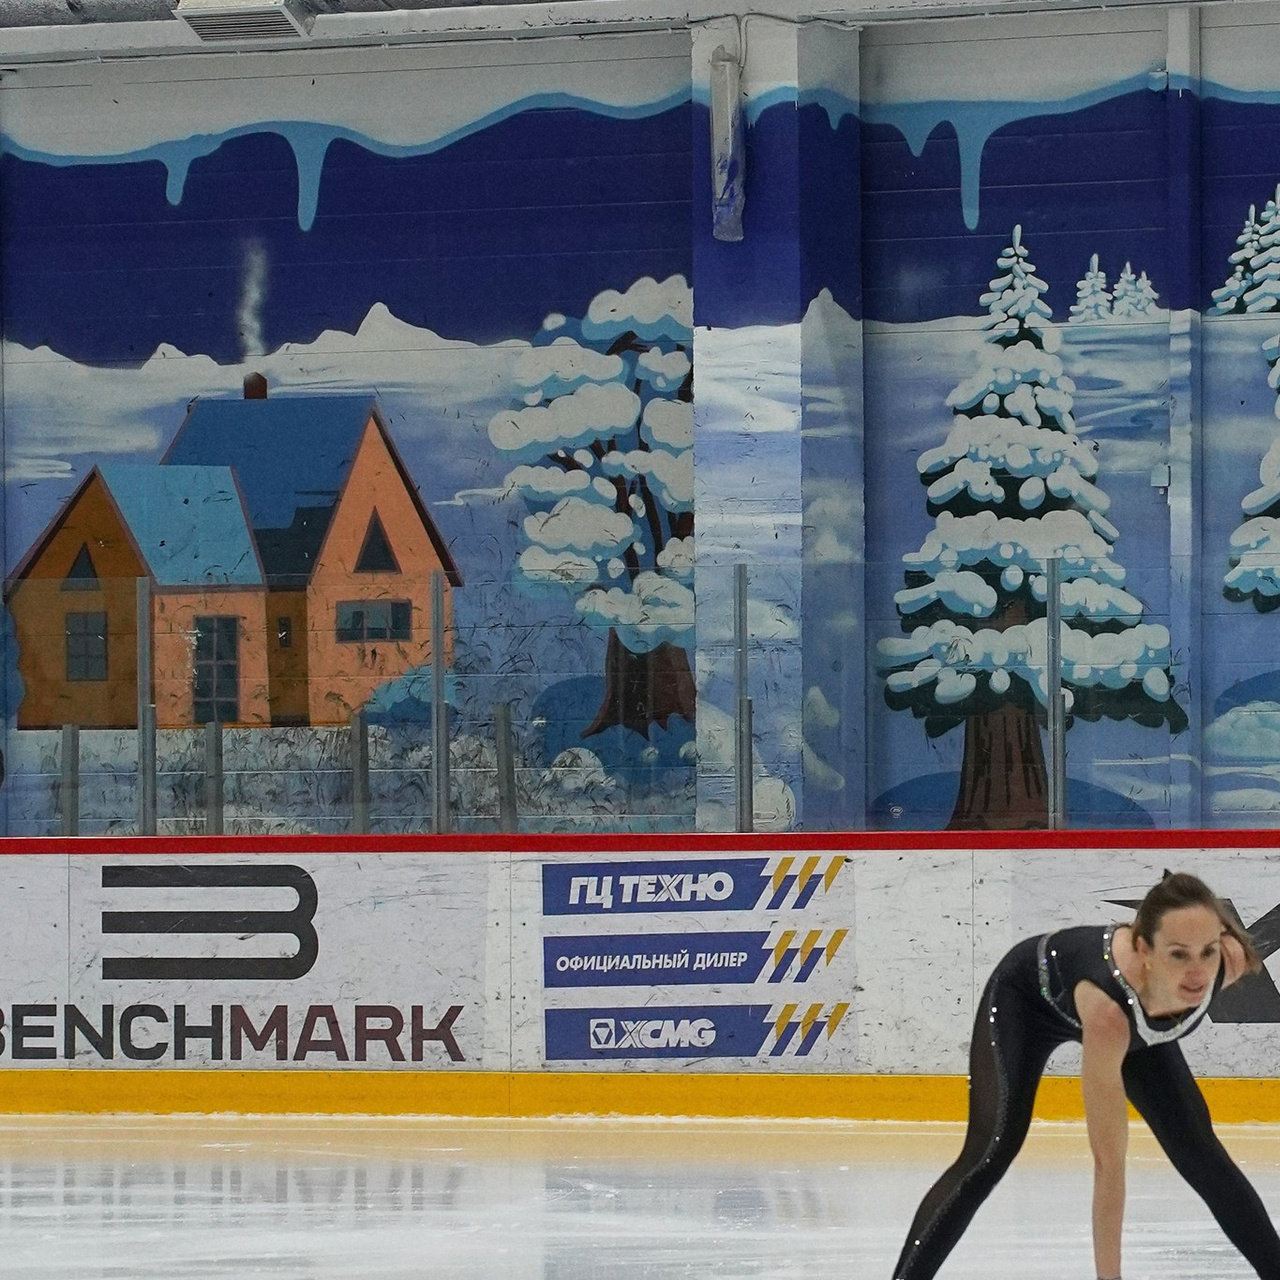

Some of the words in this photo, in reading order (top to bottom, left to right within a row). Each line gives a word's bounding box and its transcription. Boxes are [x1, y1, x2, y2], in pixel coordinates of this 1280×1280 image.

[569, 876, 613, 908] ГЦ
[619, 871, 734, 903] ТЕХНО
[556, 949, 690, 972] ОФИЦИАЛЬНЫЙ
[693, 951, 748, 971] ДИЛЕР
[0, 1004, 466, 1062] ENCHMARK
[615, 1019, 716, 1048] XCMG
